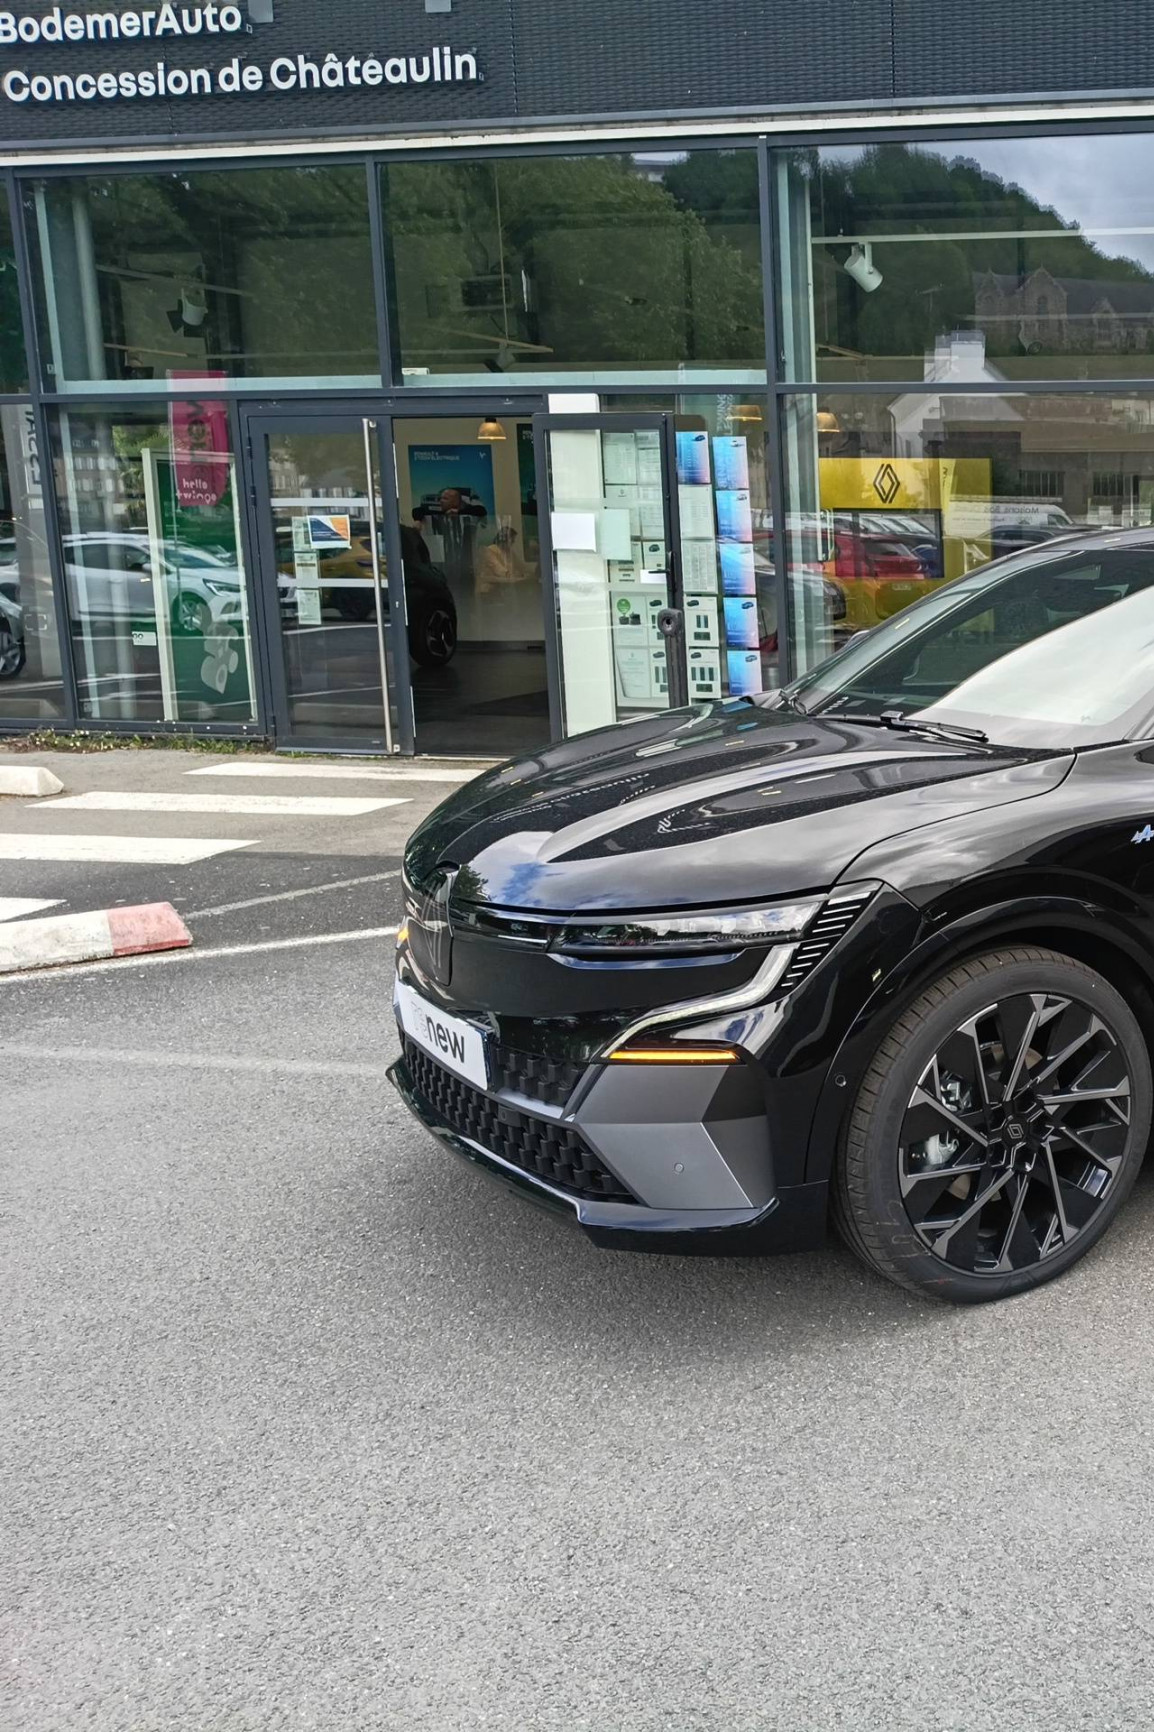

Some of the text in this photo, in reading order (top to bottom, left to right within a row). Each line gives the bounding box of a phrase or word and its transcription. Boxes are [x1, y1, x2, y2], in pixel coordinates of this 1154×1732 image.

[0, 3, 242, 43] BodemerAuto
[3, 46, 478, 102] Concession de Châteaulin
[182, 478, 208, 490] hello
